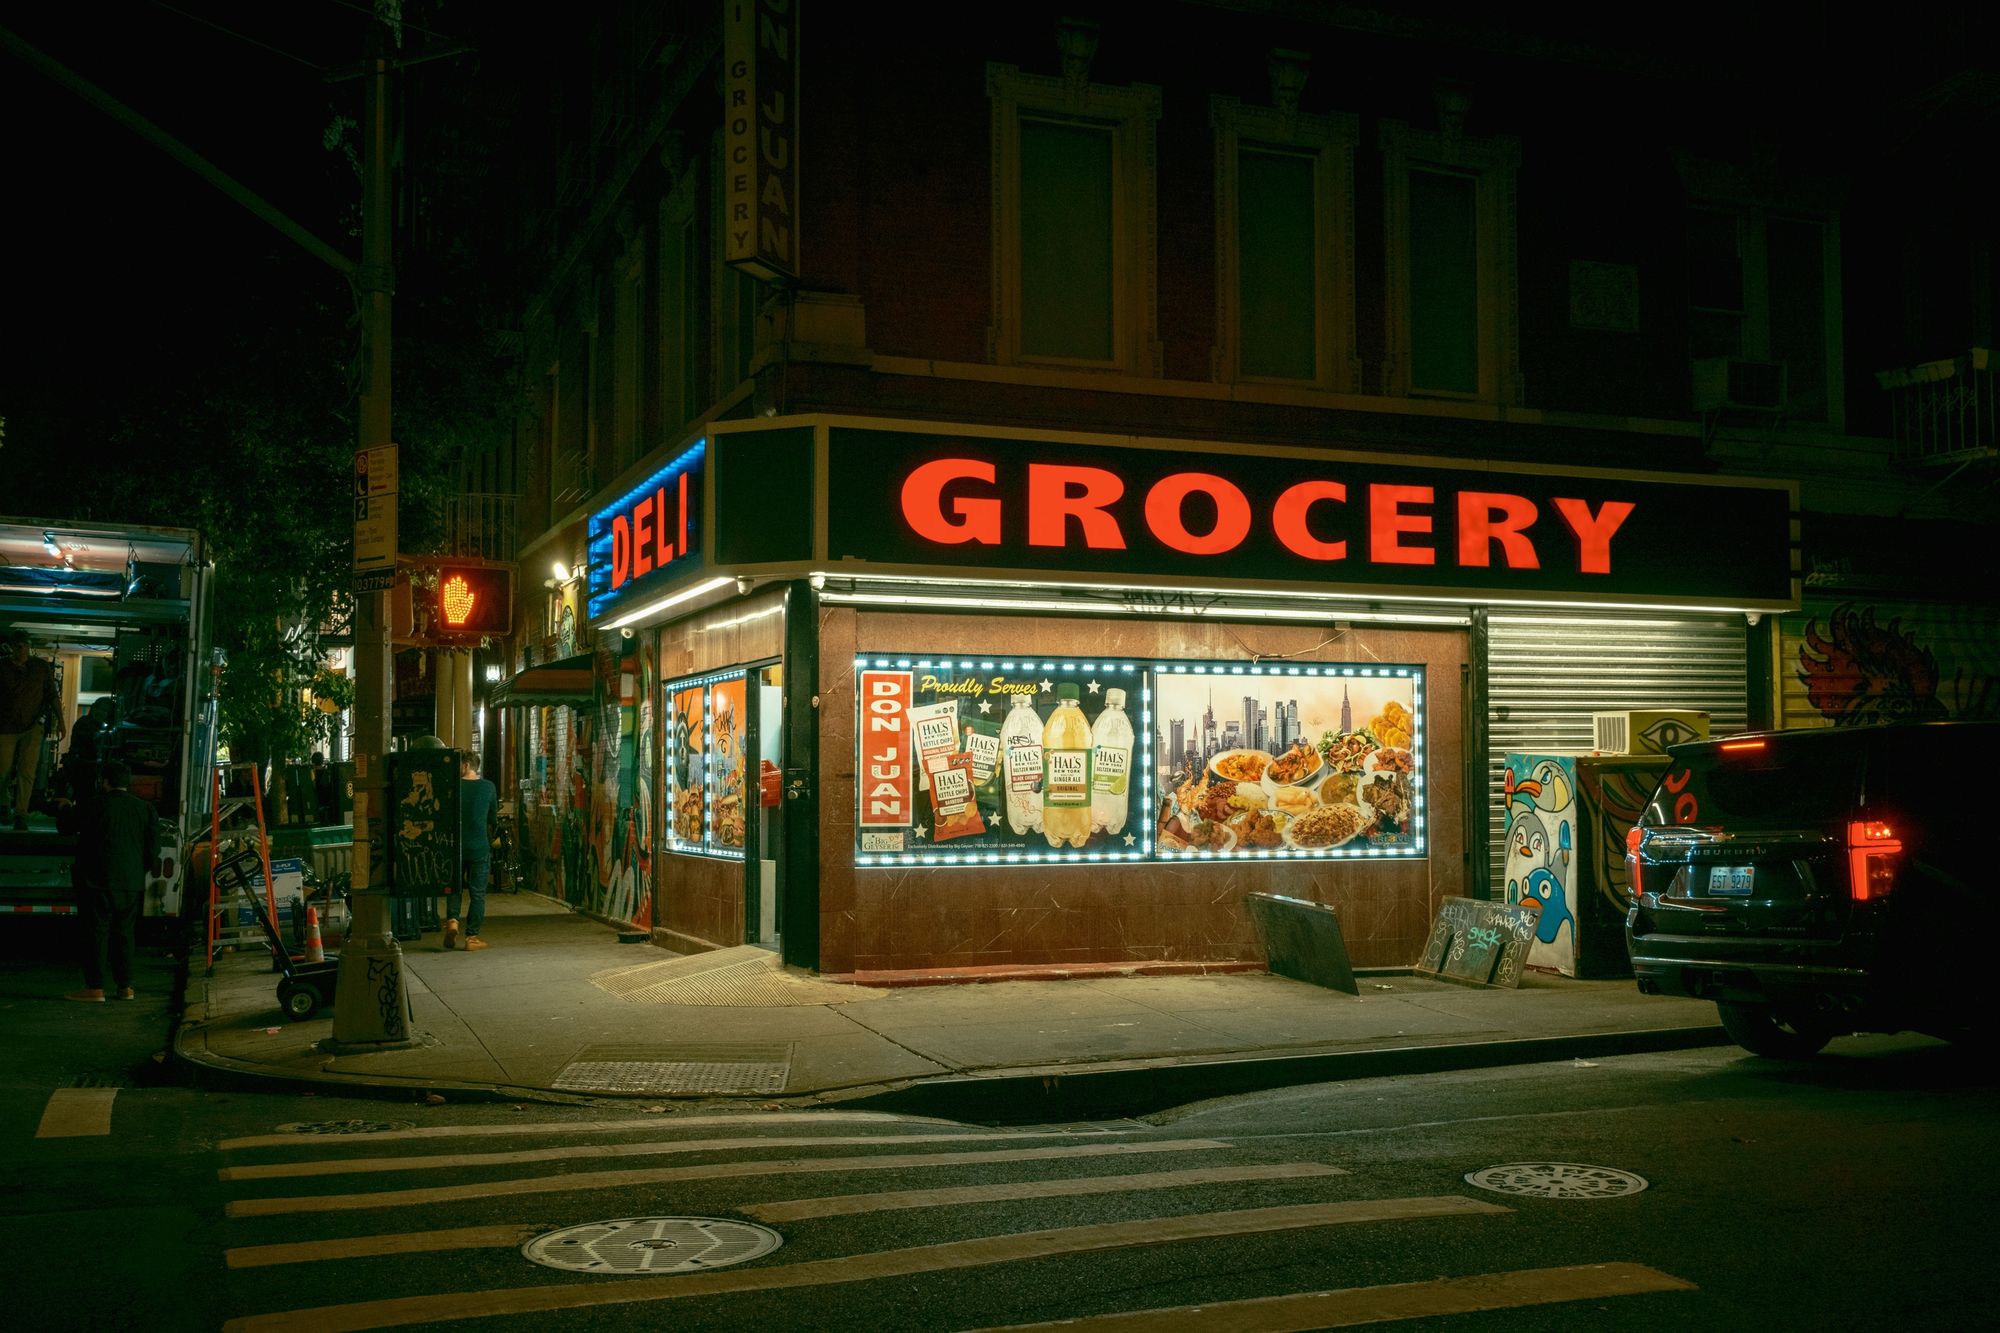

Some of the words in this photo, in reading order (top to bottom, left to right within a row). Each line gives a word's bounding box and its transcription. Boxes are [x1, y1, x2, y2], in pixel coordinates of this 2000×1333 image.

[730, 60, 750, 250] GROCERY
[760, 89, 789, 263] JUAN
[901, 458, 1636, 575] GROCERY
[611, 472, 689, 590] DELI
[920, 674, 984, 698] Proudly
[988, 676, 1039, 695] Serves
[870, 681, 902, 731] DON
[922, 721, 949, 736] HAL'S
[922, 739, 940, 748] KETTLE
[940, 736, 953, 745] CHIPS
[970, 736, 996, 752] HAL'S
[1014, 749, 1039, 762] HAL'S
[1054, 756, 1082, 769] HAL'S
[1099, 750, 1124, 764] HAL'S
[1096, 766, 1112, 774] SELTZER
[870, 747, 902, 815] JUAN
[938, 773, 964, 787] HAL'S
[938, 790, 955, 799] KETTLE
[955, 788, 968, 796] CHIPS
